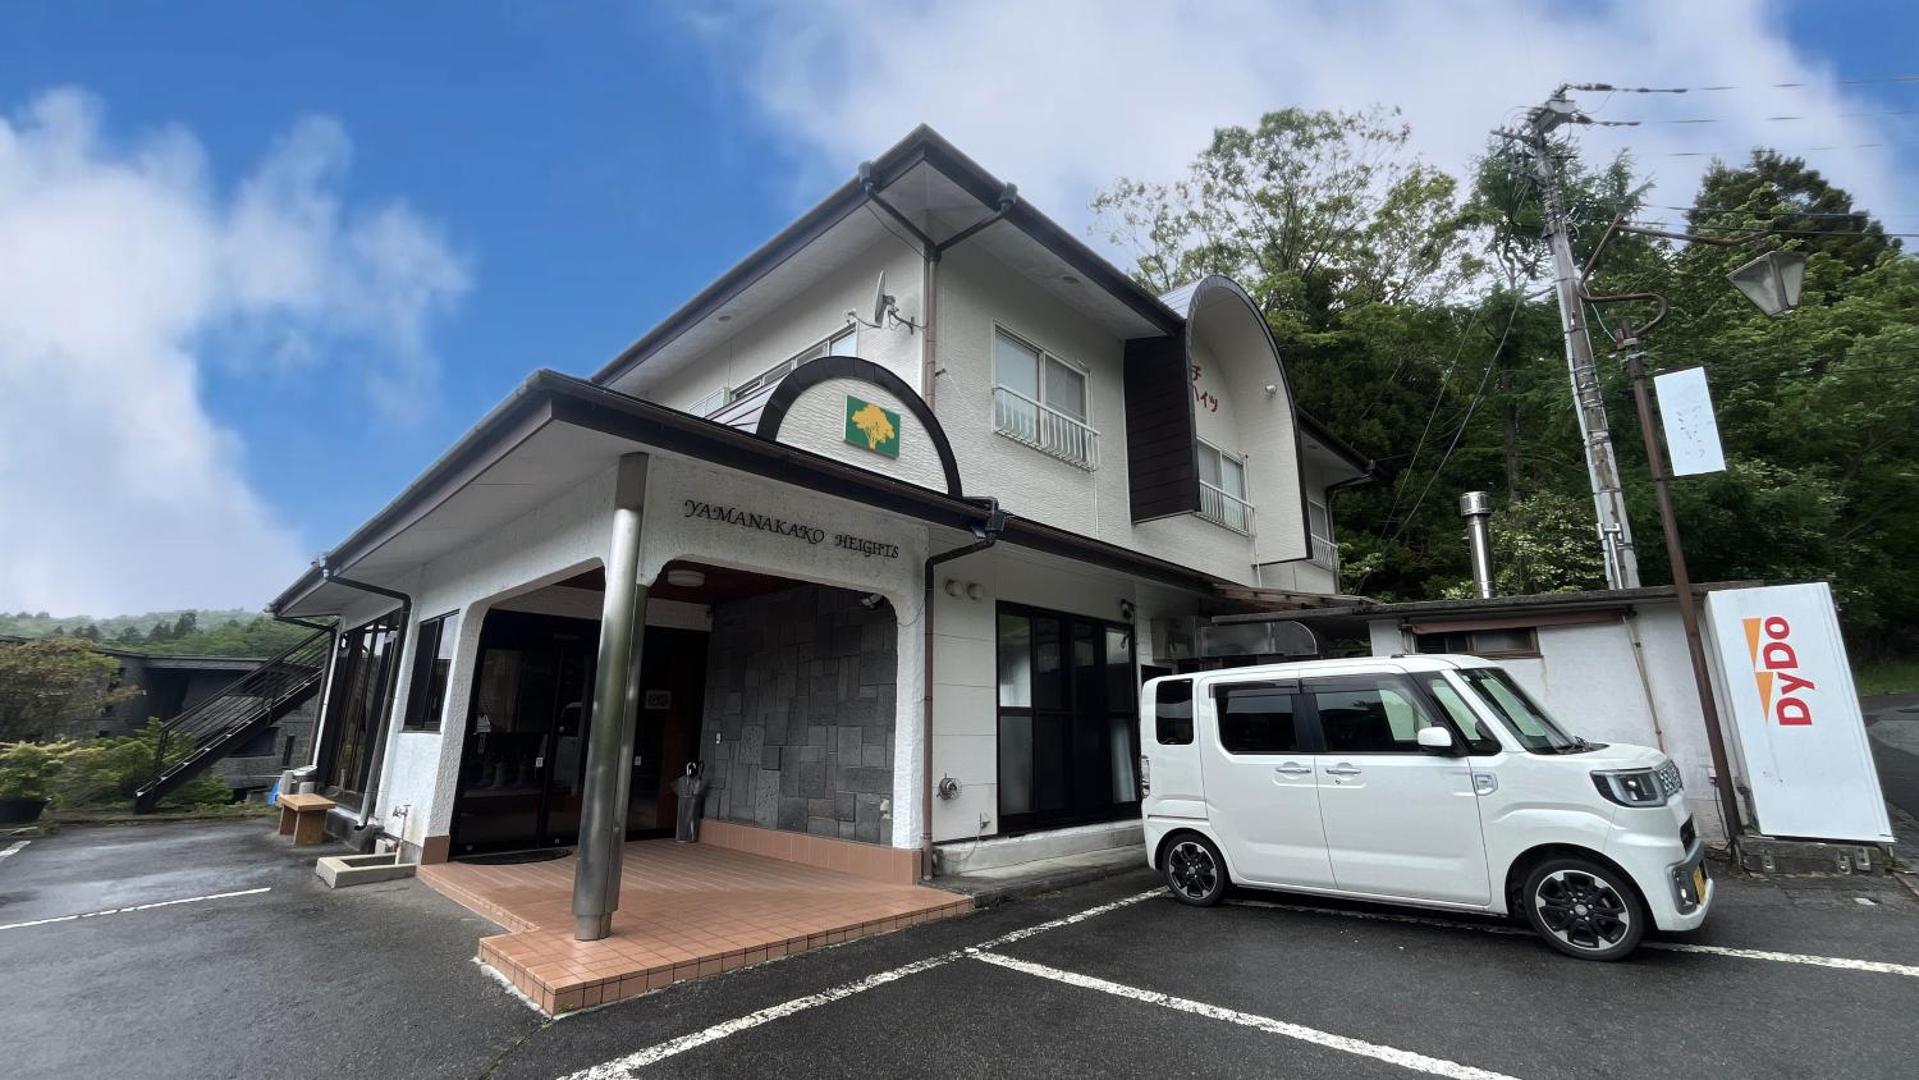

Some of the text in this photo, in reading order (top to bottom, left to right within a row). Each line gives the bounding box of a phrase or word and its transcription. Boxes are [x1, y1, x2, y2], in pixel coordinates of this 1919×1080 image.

[684, 499, 899, 559] YAMANAKAKO HEIGHTS
[1763, 616, 1816, 726] DyDo
